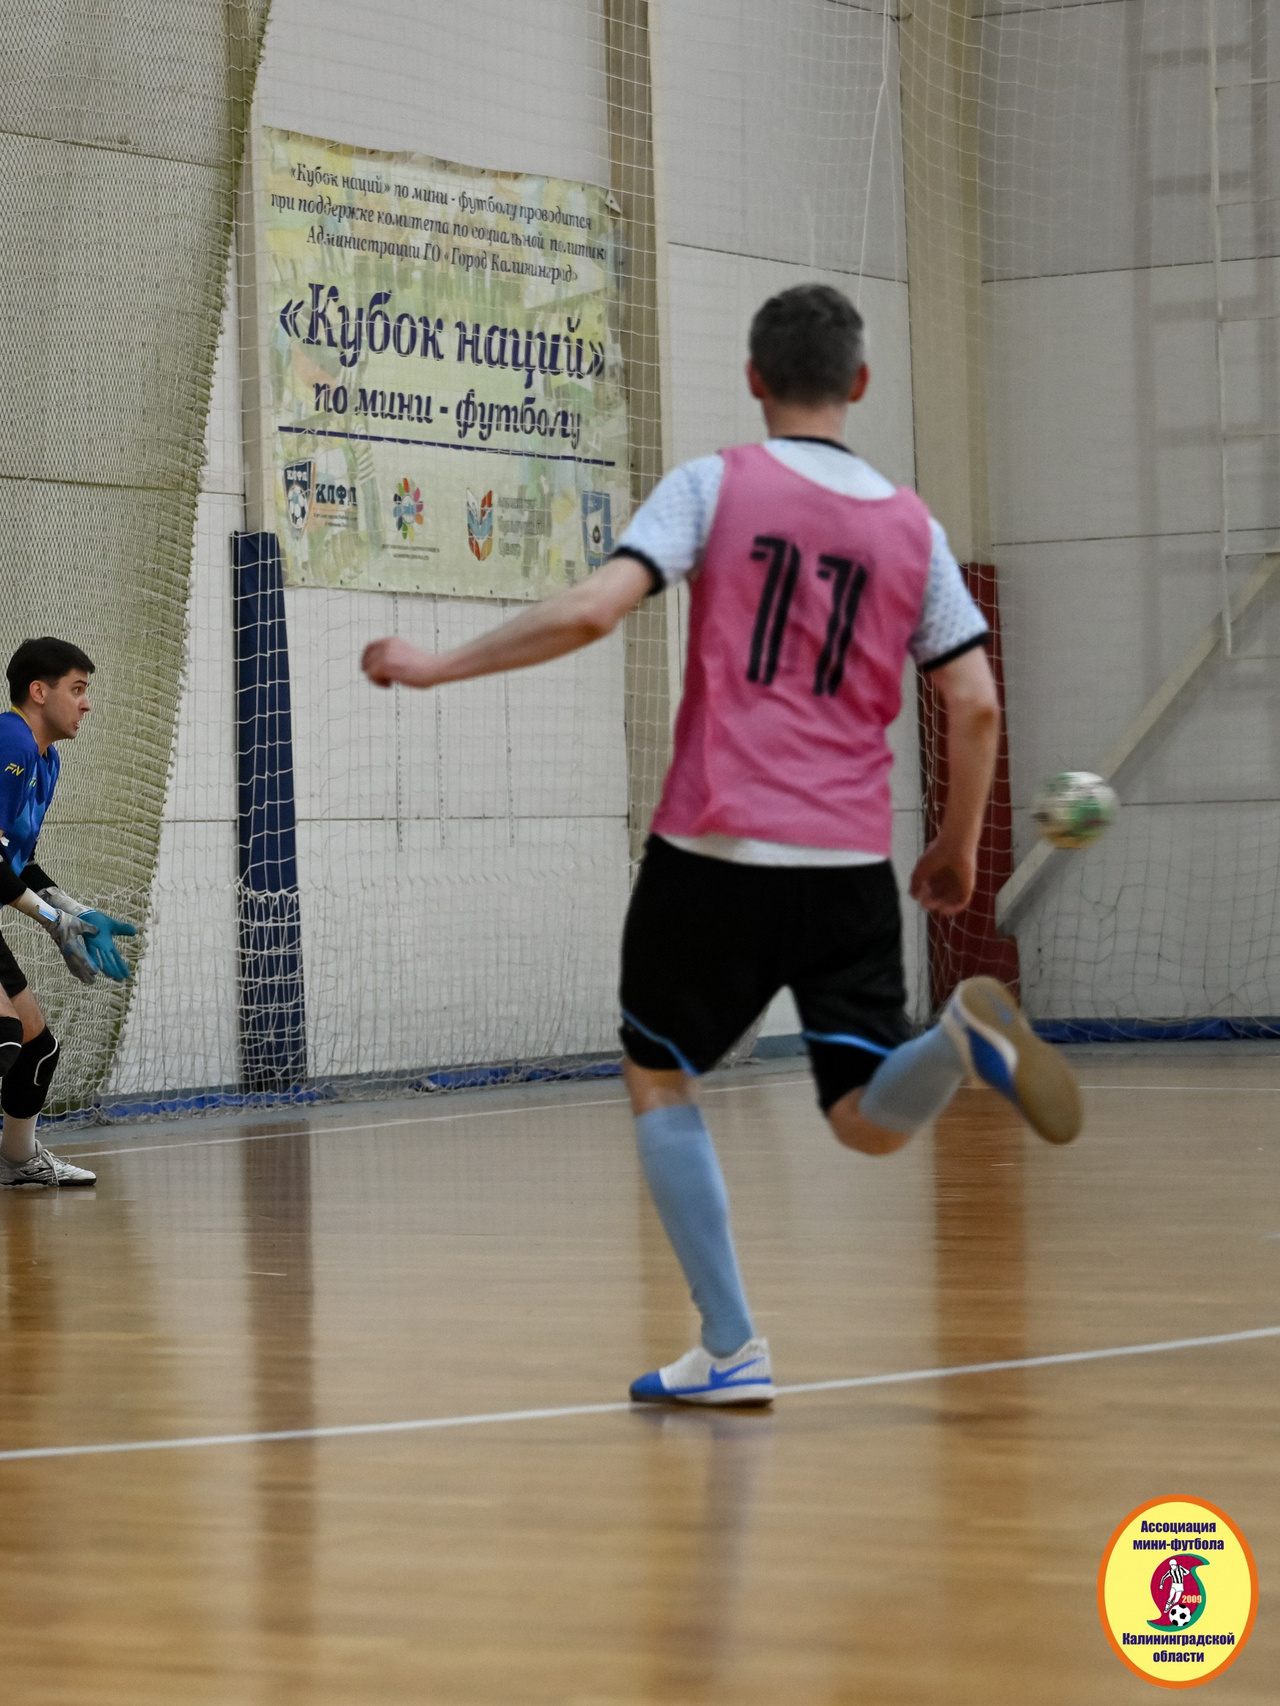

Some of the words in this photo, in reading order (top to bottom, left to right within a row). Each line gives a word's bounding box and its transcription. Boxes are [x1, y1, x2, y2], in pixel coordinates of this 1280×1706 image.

[271, 193, 295, 213] при
[298, 195, 374, 223] поддержке
[377, 210, 448, 234] комитета
[453, 223, 468, 238] по
[471, 226, 544, 249] социальной
[290, 163, 338, 187] «Кубок
[342, 174, 390, 196] наций»
[394, 184, 409, 198] по
[412, 187, 448, 205] мини
[459, 191, 518, 221] футболу
[520, 205, 592, 230] проводится
[307, 225, 420, 261] Администрации
[423, 242, 441, 262] ГО
[280, 283, 444, 368] «Кубок
[455, 317, 604, 389] наций»
[313, 383, 348, 414] по
[354, 388, 433, 424] мини
[456, 388, 581, 450] футболу
[746, 534, 868, 697] 11
